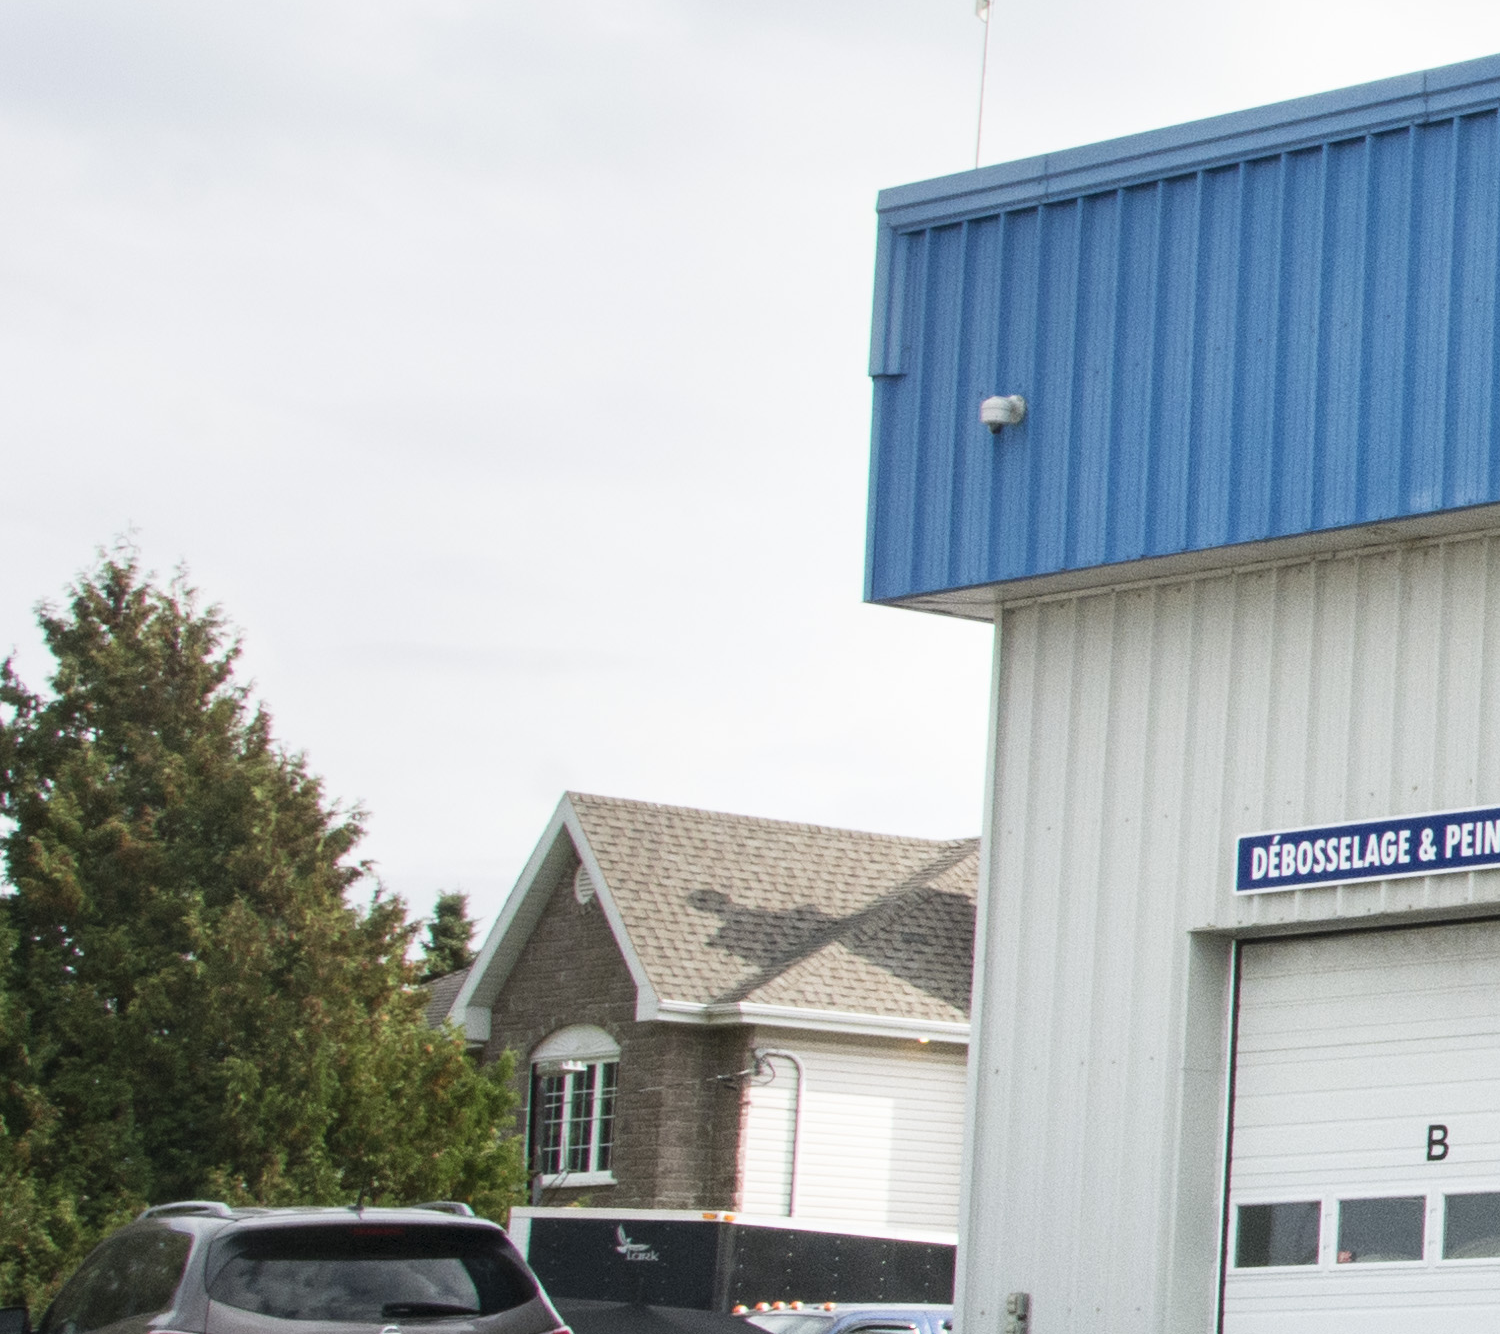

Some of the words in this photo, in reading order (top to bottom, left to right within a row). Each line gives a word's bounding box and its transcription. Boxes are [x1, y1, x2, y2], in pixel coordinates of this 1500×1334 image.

[1250, 829, 1411, 881] DÉBOSSELAGE
[1418, 827, 1437, 862] &
[1425, 1124, 1450, 1162] B
